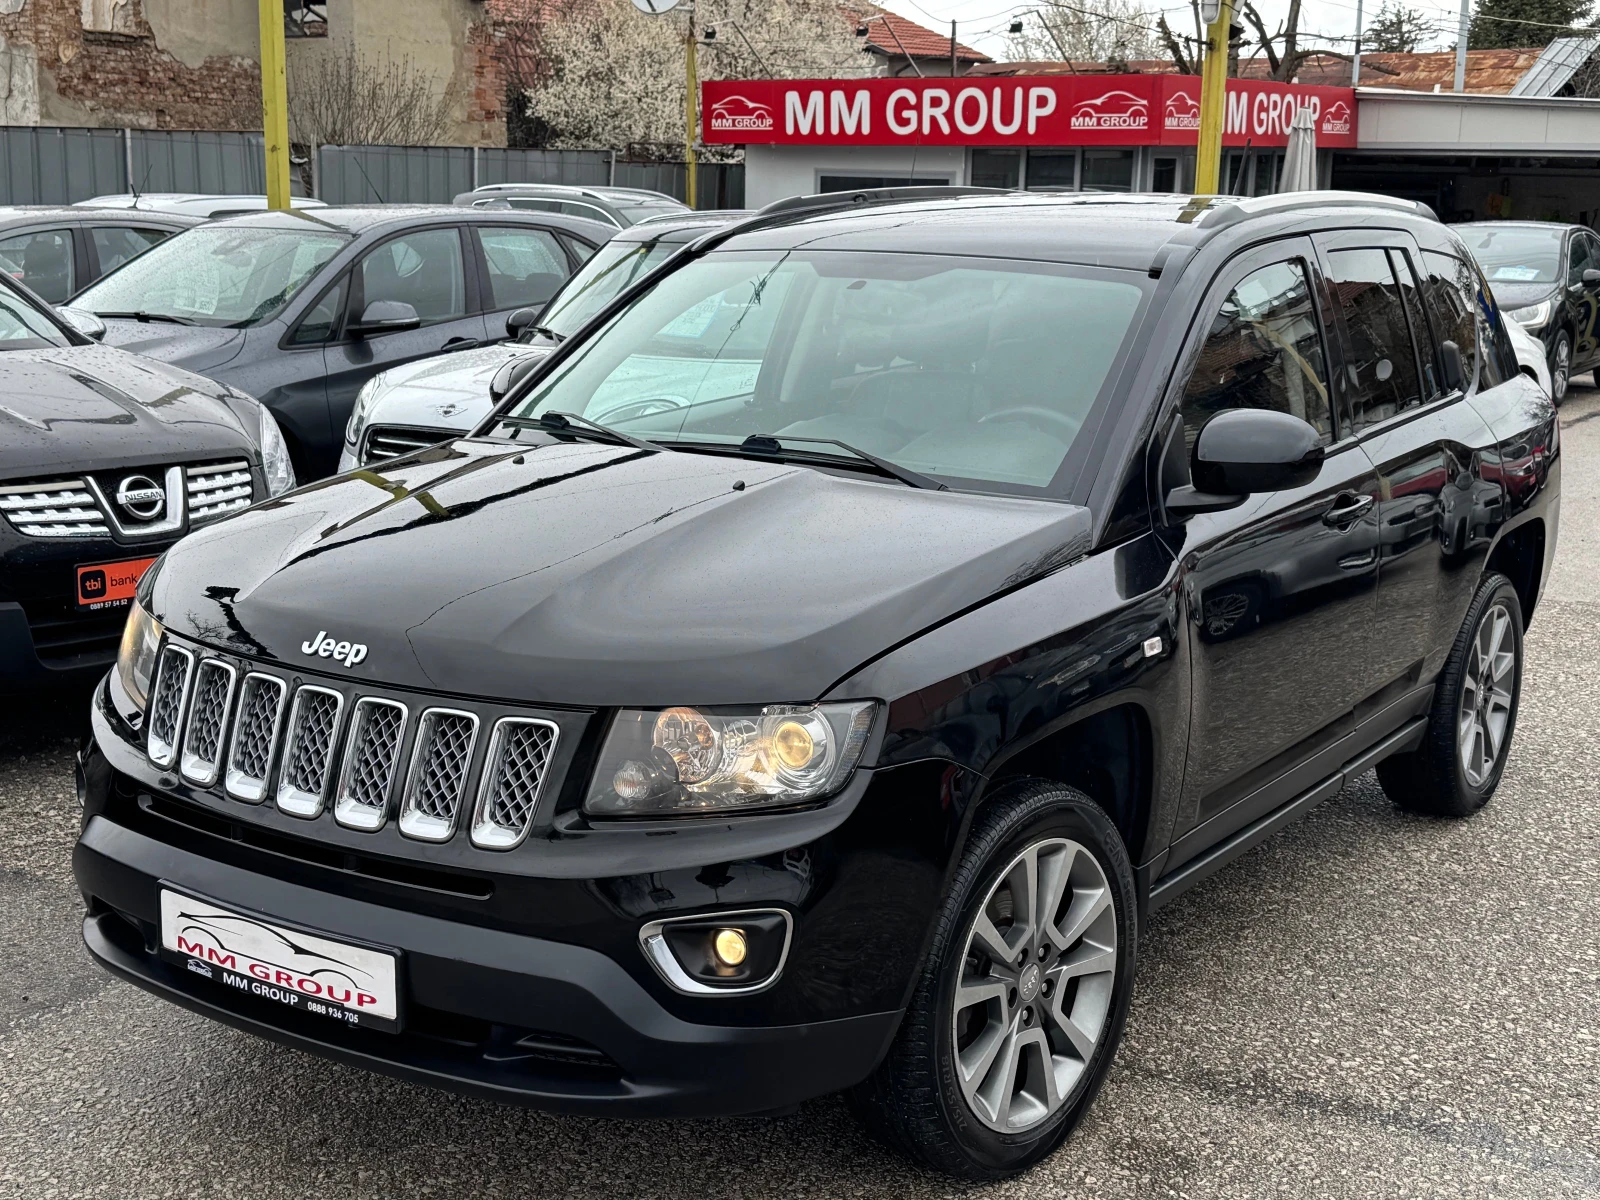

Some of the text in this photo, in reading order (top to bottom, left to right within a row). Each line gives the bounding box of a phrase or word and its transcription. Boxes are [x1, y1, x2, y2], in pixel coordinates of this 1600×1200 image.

[785, 86, 1057, 135] MM GROUP
[1221, 91, 1248, 135] M
[712, 118, 773, 128] MM GROUP
[1071, 116, 1148, 127] MM GROUP
[1165, 117, 1178, 127] MM
[1322, 122, 1350, 132] MM GROUP
[124, 490, 162, 501] NISSAN
[85, 573, 138, 591] tbi bank
[301, 630, 369, 668] Jeep
[177, 935, 377, 1007] MM GROUP
[223, 972, 248, 990] MM
[252, 983, 298, 1005] GROUP
[307, 1001, 359, 1023] 0888 936 705
